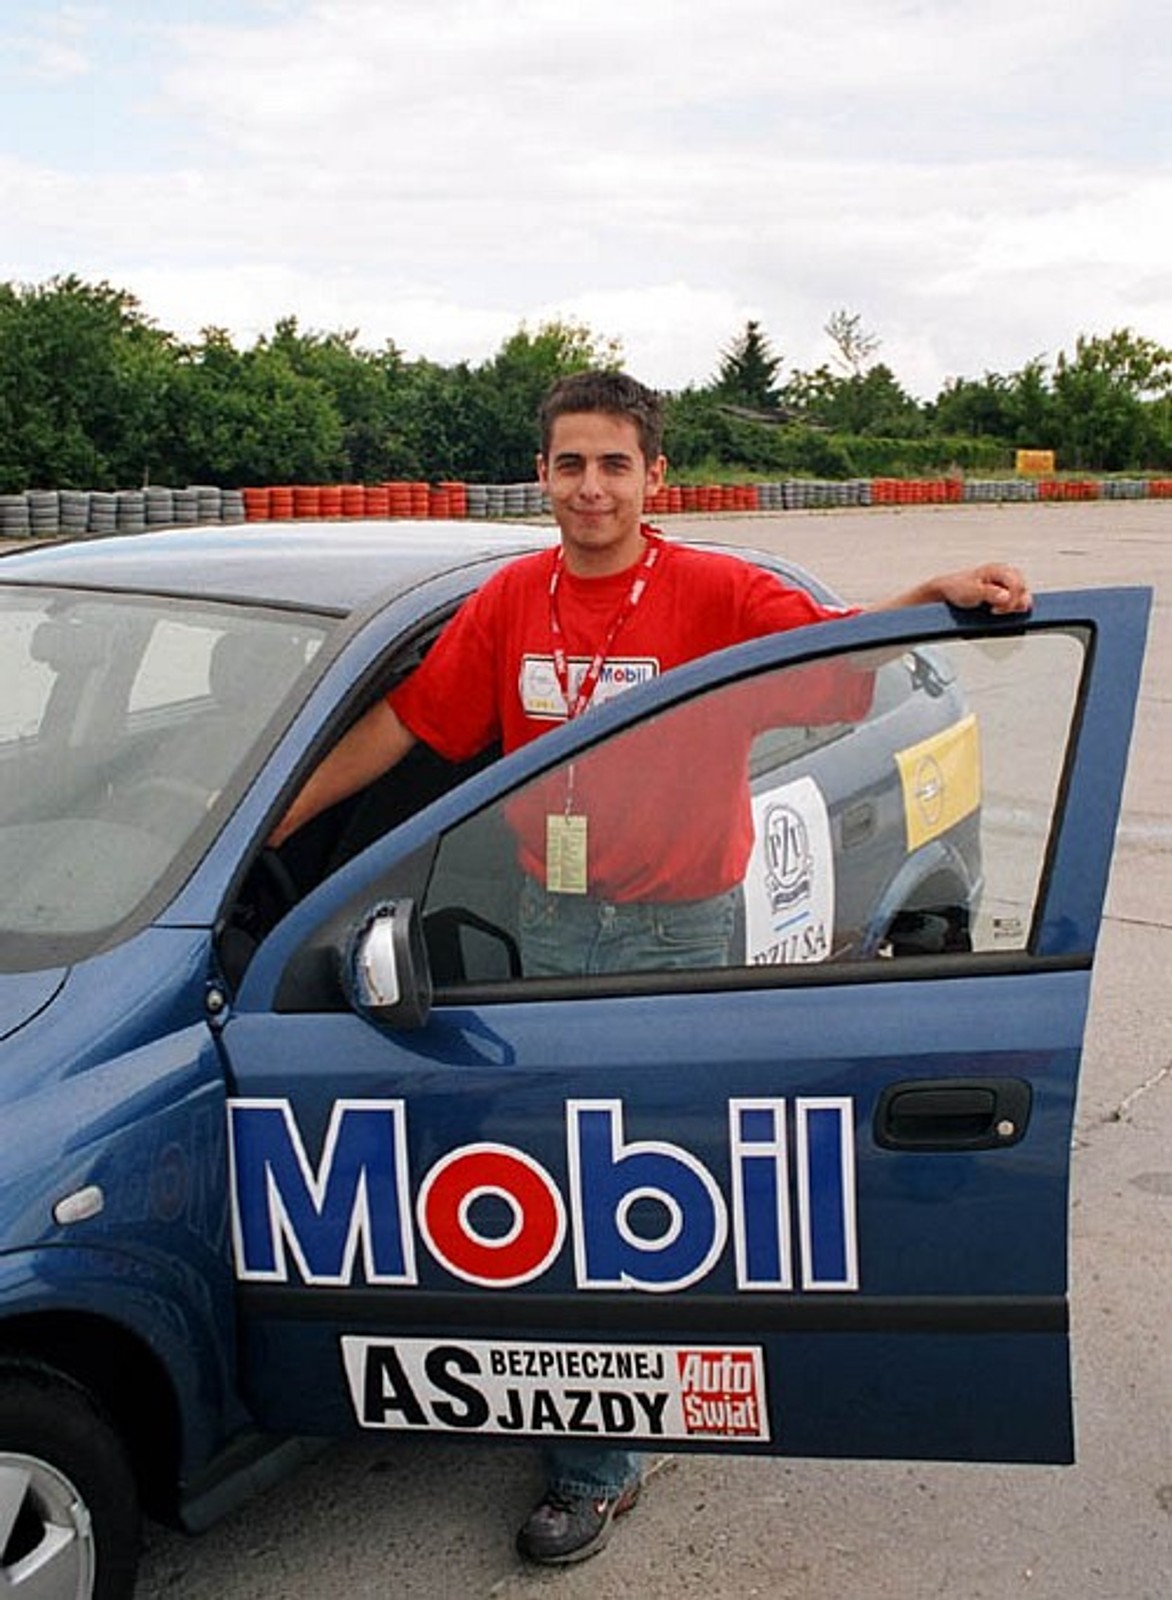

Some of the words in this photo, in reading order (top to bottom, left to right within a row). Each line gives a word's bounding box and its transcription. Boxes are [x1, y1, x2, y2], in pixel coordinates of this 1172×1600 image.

[600, 667, 647, 684] Mobil
[226, 1096, 860, 1292] Mobil
[363, 1344, 490, 1428] AS
[490, 1349, 664, 1380] BEZPIECZNEJ
[682, 1353, 752, 1393] Auto
[497, 1388, 669, 1435] JAZDY
